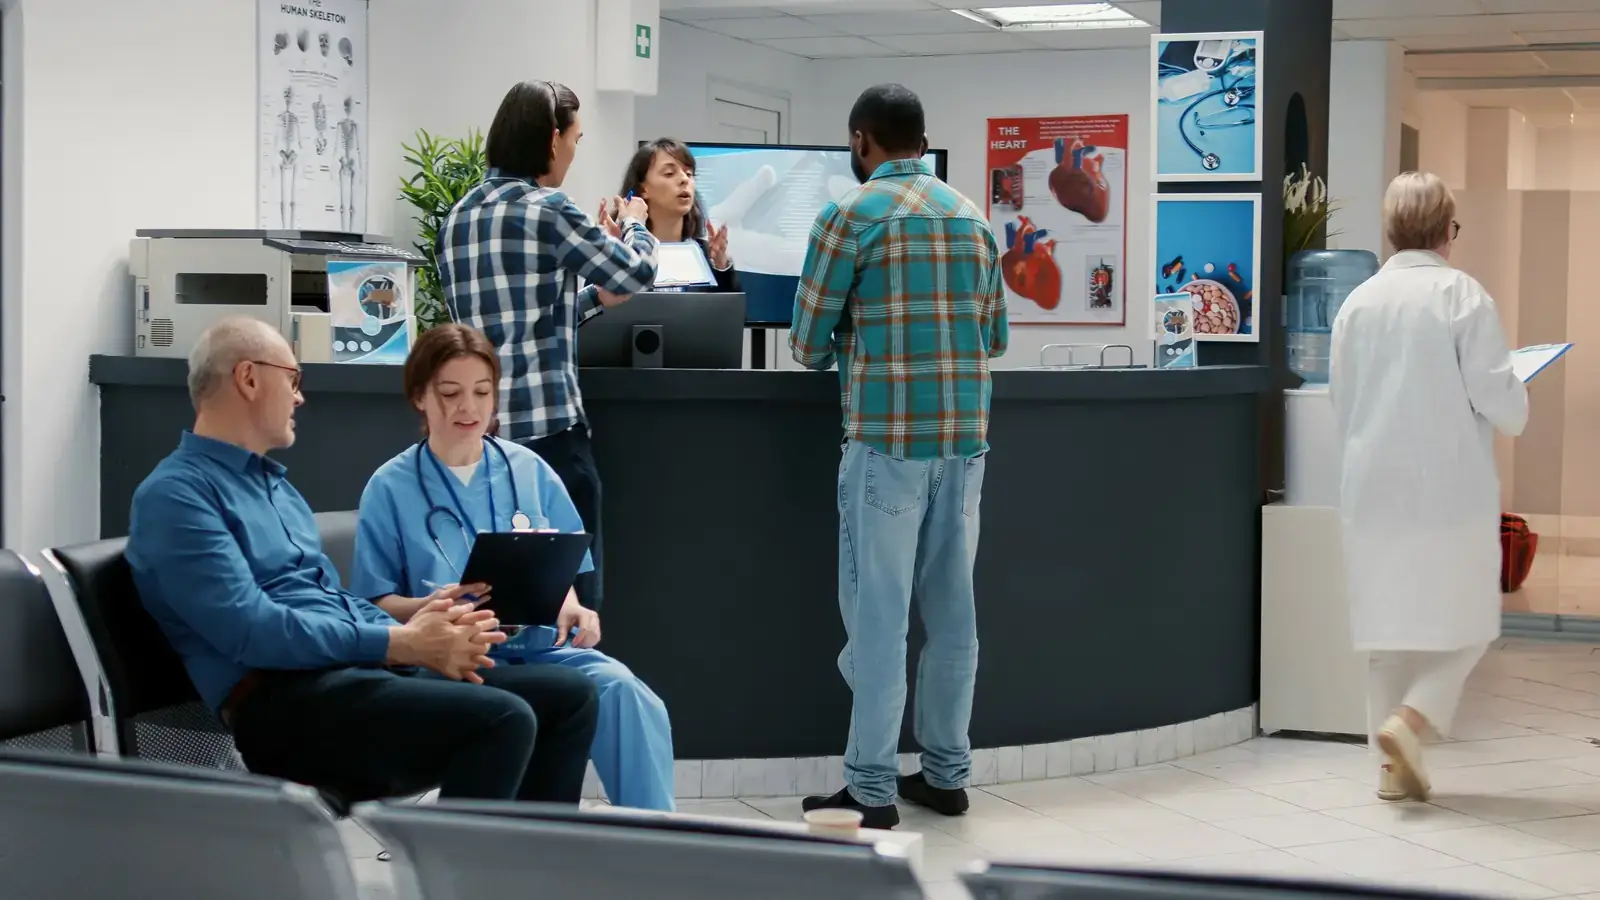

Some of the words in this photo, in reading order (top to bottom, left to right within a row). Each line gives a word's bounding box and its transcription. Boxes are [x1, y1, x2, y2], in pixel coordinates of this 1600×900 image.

[280, 4, 308, 17] HUMAN
[309, 9, 346, 24] SKELETON
[998, 126, 1020, 135] THE
[990, 140, 1027, 149] HEART
